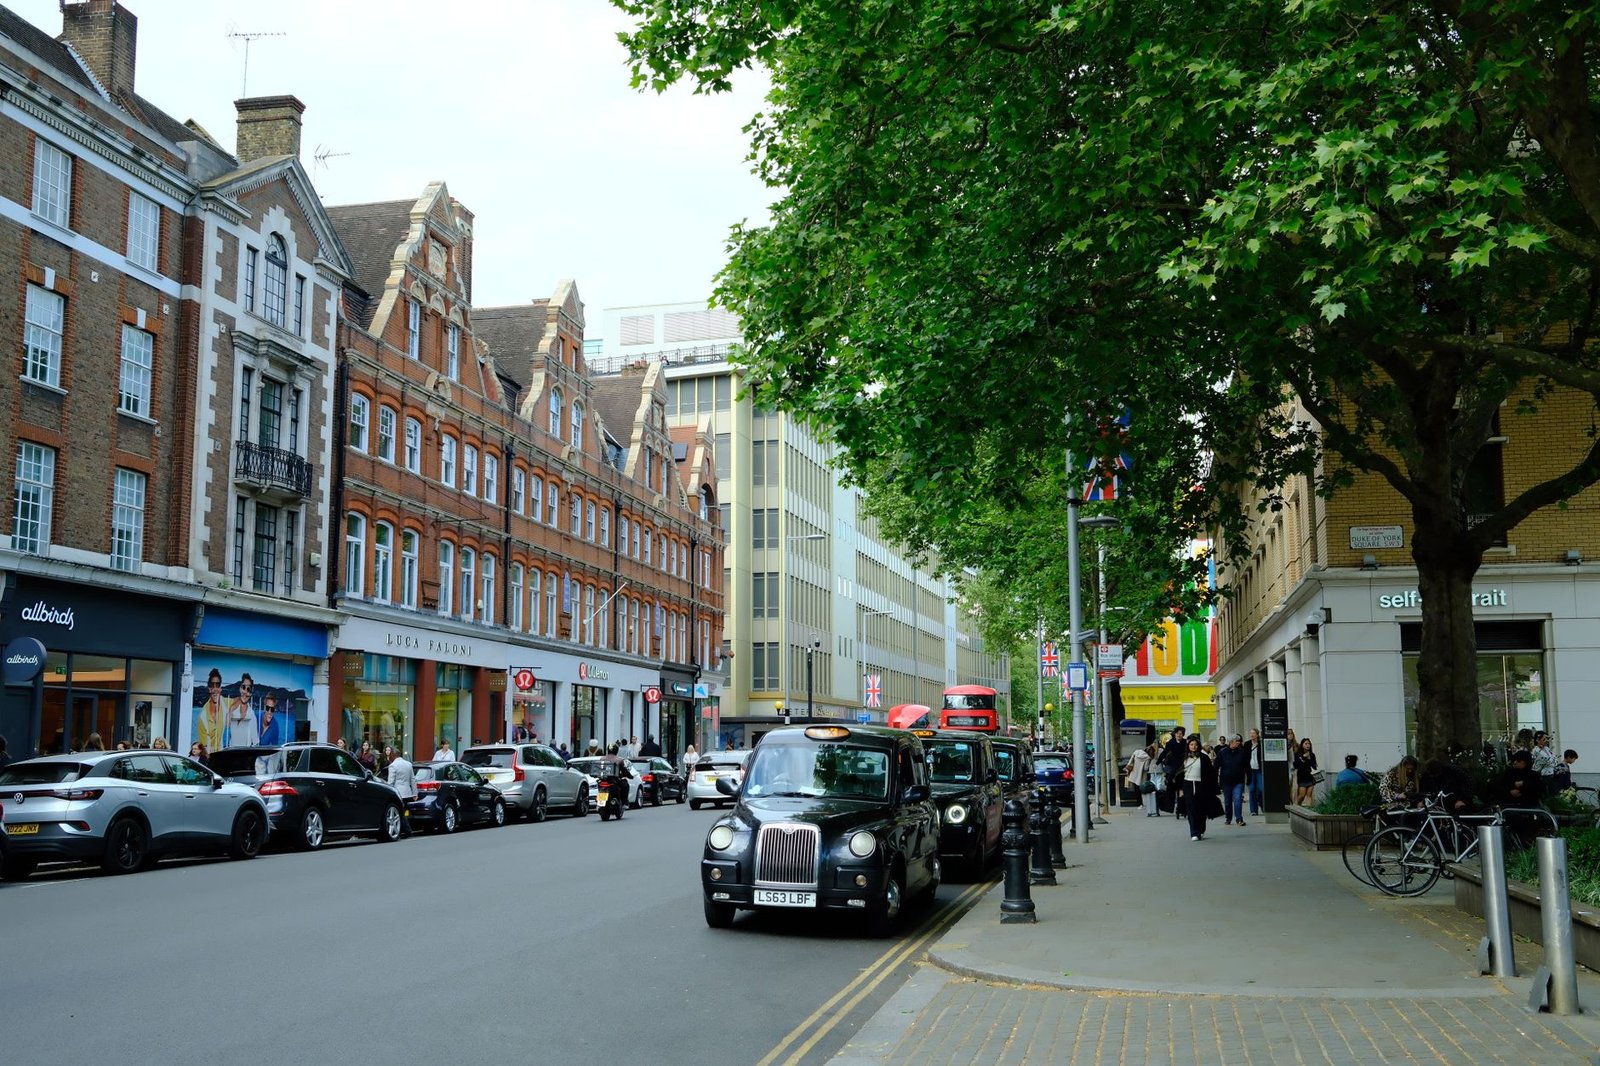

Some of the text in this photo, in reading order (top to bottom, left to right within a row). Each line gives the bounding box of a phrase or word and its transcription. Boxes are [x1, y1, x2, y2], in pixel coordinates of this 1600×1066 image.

[21, 600, 75, 631] allbirds
[386, 632, 472, 656] LUCA FALONI
[6, 653, 39, 666] allbirds
[758, 891, 811, 904] LS63 LBF
